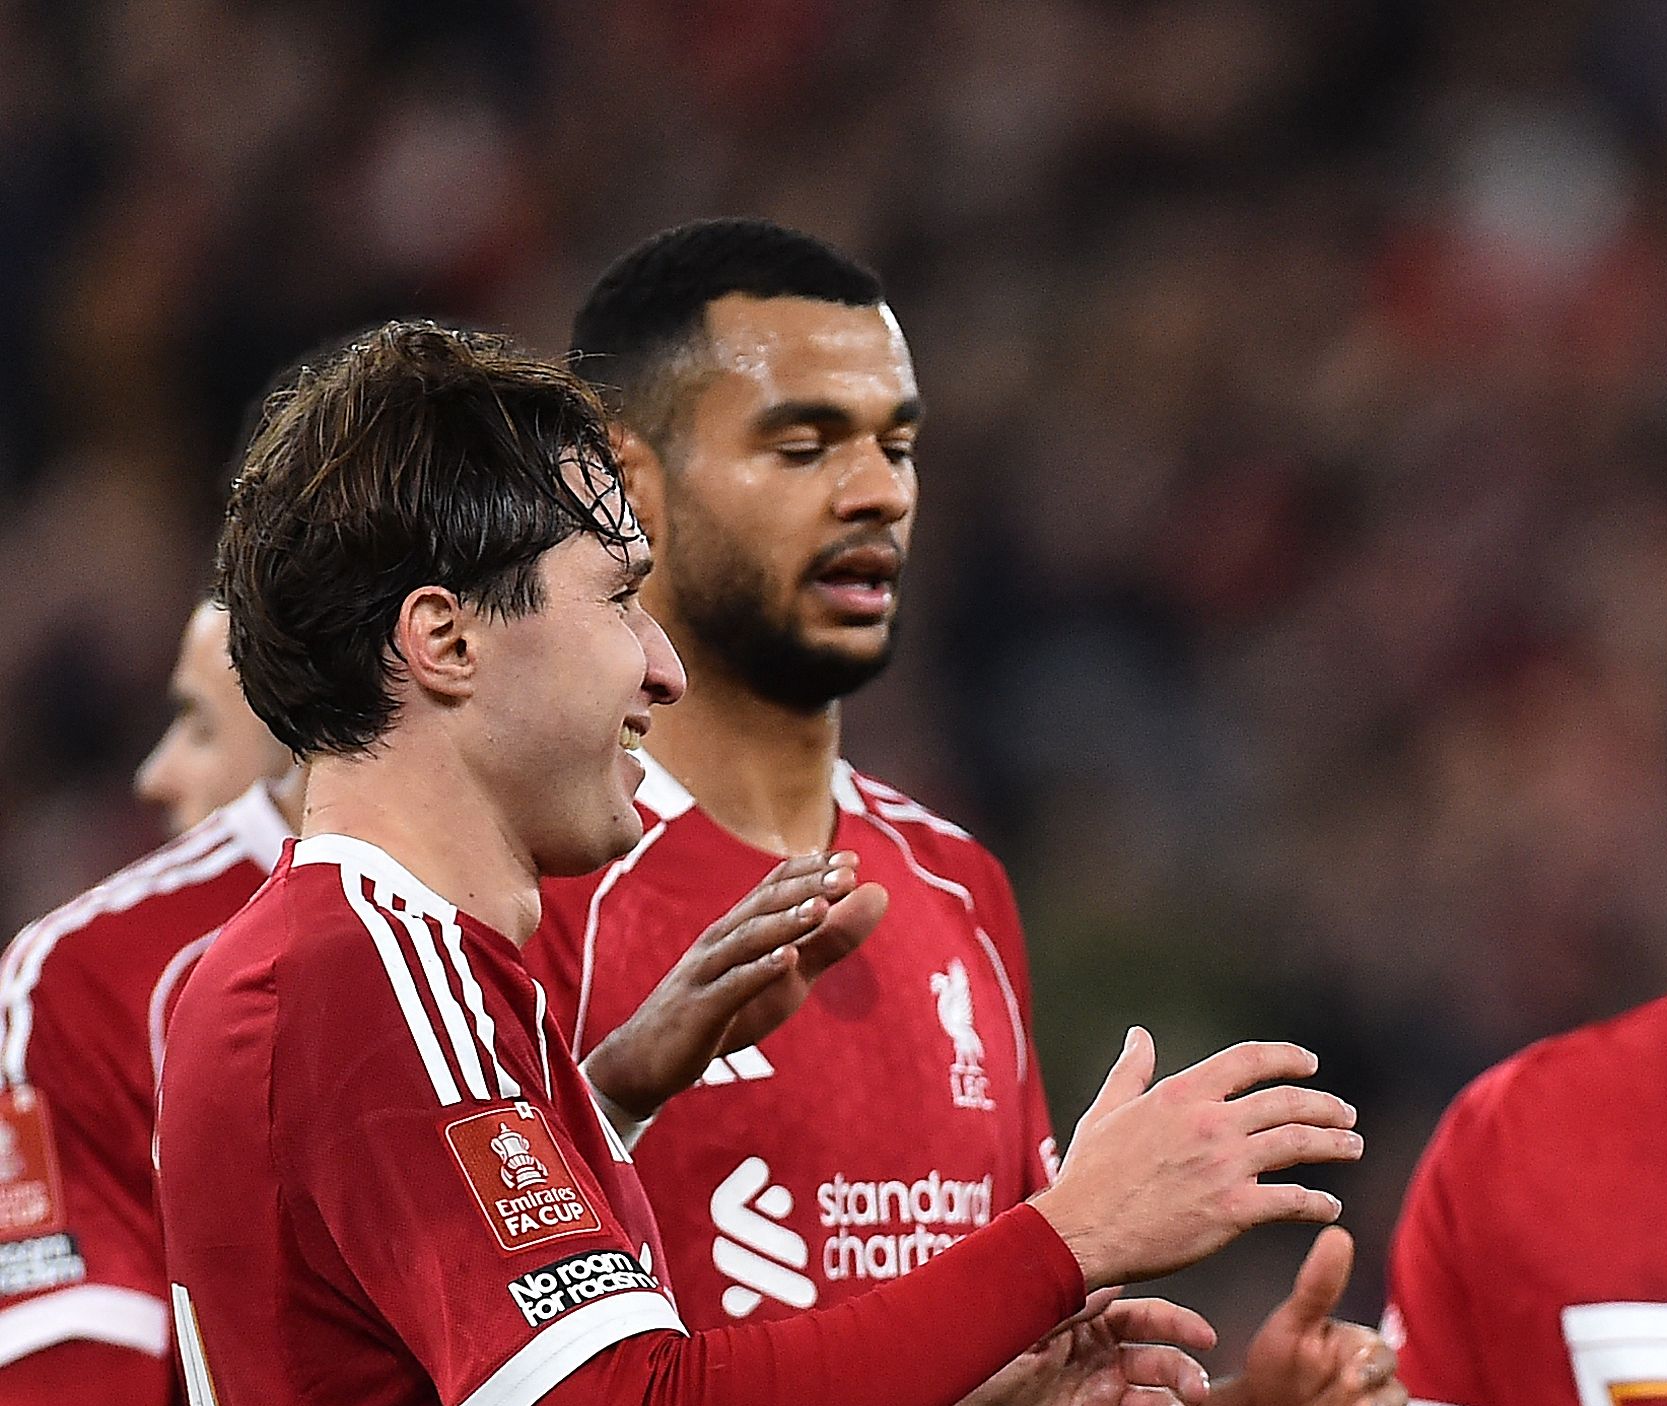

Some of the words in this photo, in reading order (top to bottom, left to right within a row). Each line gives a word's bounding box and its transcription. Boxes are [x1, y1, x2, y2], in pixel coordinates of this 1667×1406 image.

[495, 1186, 577, 1218] Emirates
[504, 1212, 540, 1236] FA
[538, 1202, 584, 1227] CUP
[816, 1169, 992, 1228] standard
[507, 1271, 558, 1304] No
[556, 1252, 634, 1286] room
[823, 1224, 968, 1281] chart
[519, 1292, 565, 1328] for
[567, 1271, 660, 1304] racism
